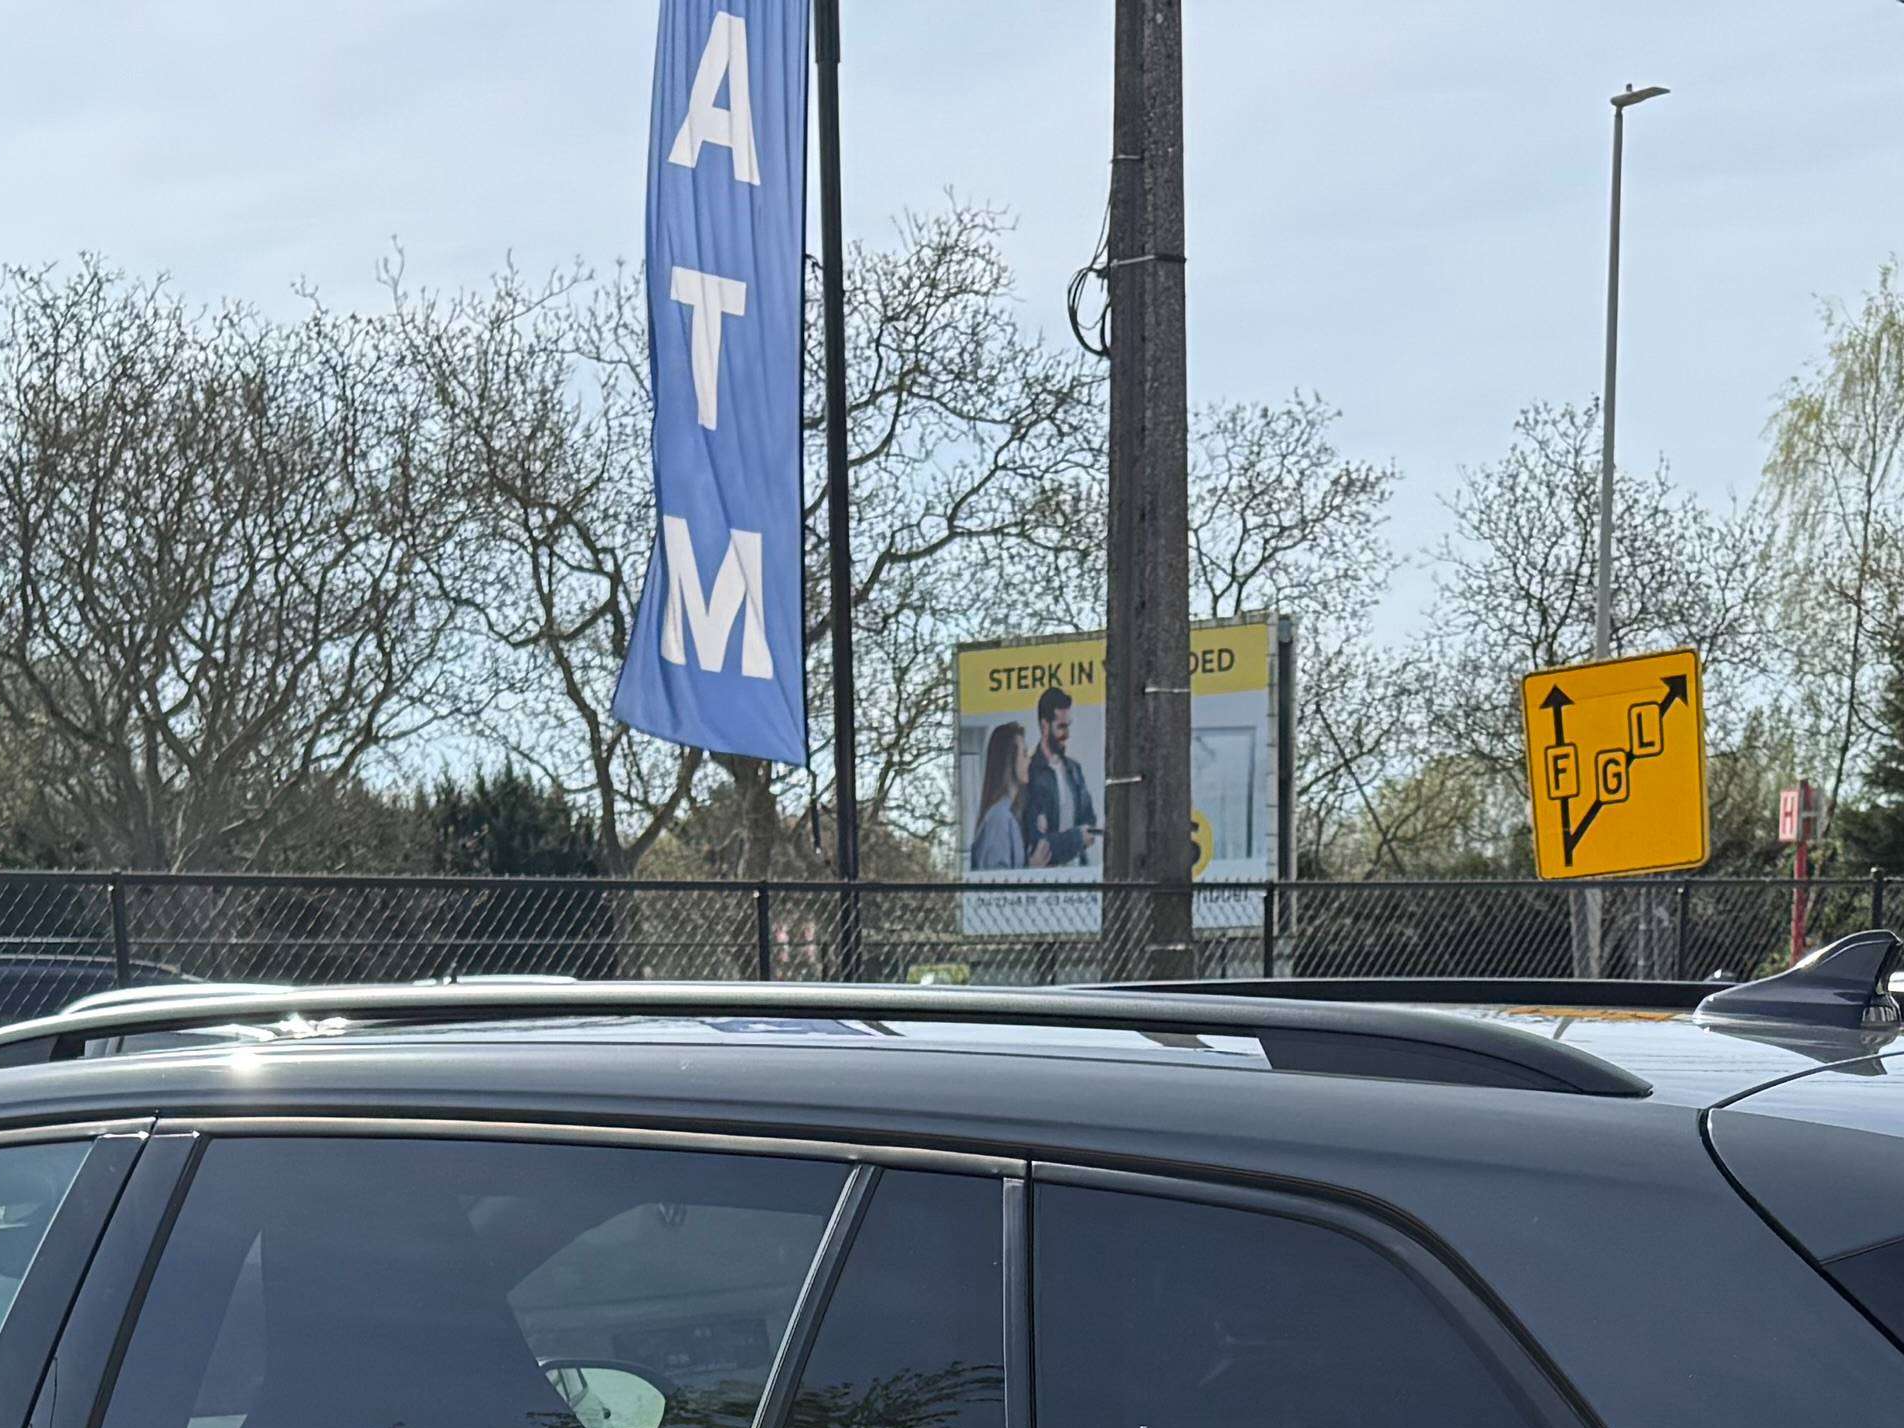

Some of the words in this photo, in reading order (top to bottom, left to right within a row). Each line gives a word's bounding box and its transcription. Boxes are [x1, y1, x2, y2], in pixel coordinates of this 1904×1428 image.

[661, 11, 773, 681] ATM
[988, 663, 1063, 693] STERK
[1070, 658, 1094, 686] IN
[1636, 711, 1655, 749] L
[1552, 752, 1570, 791] F
[1602, 757, 1622, 795] G
